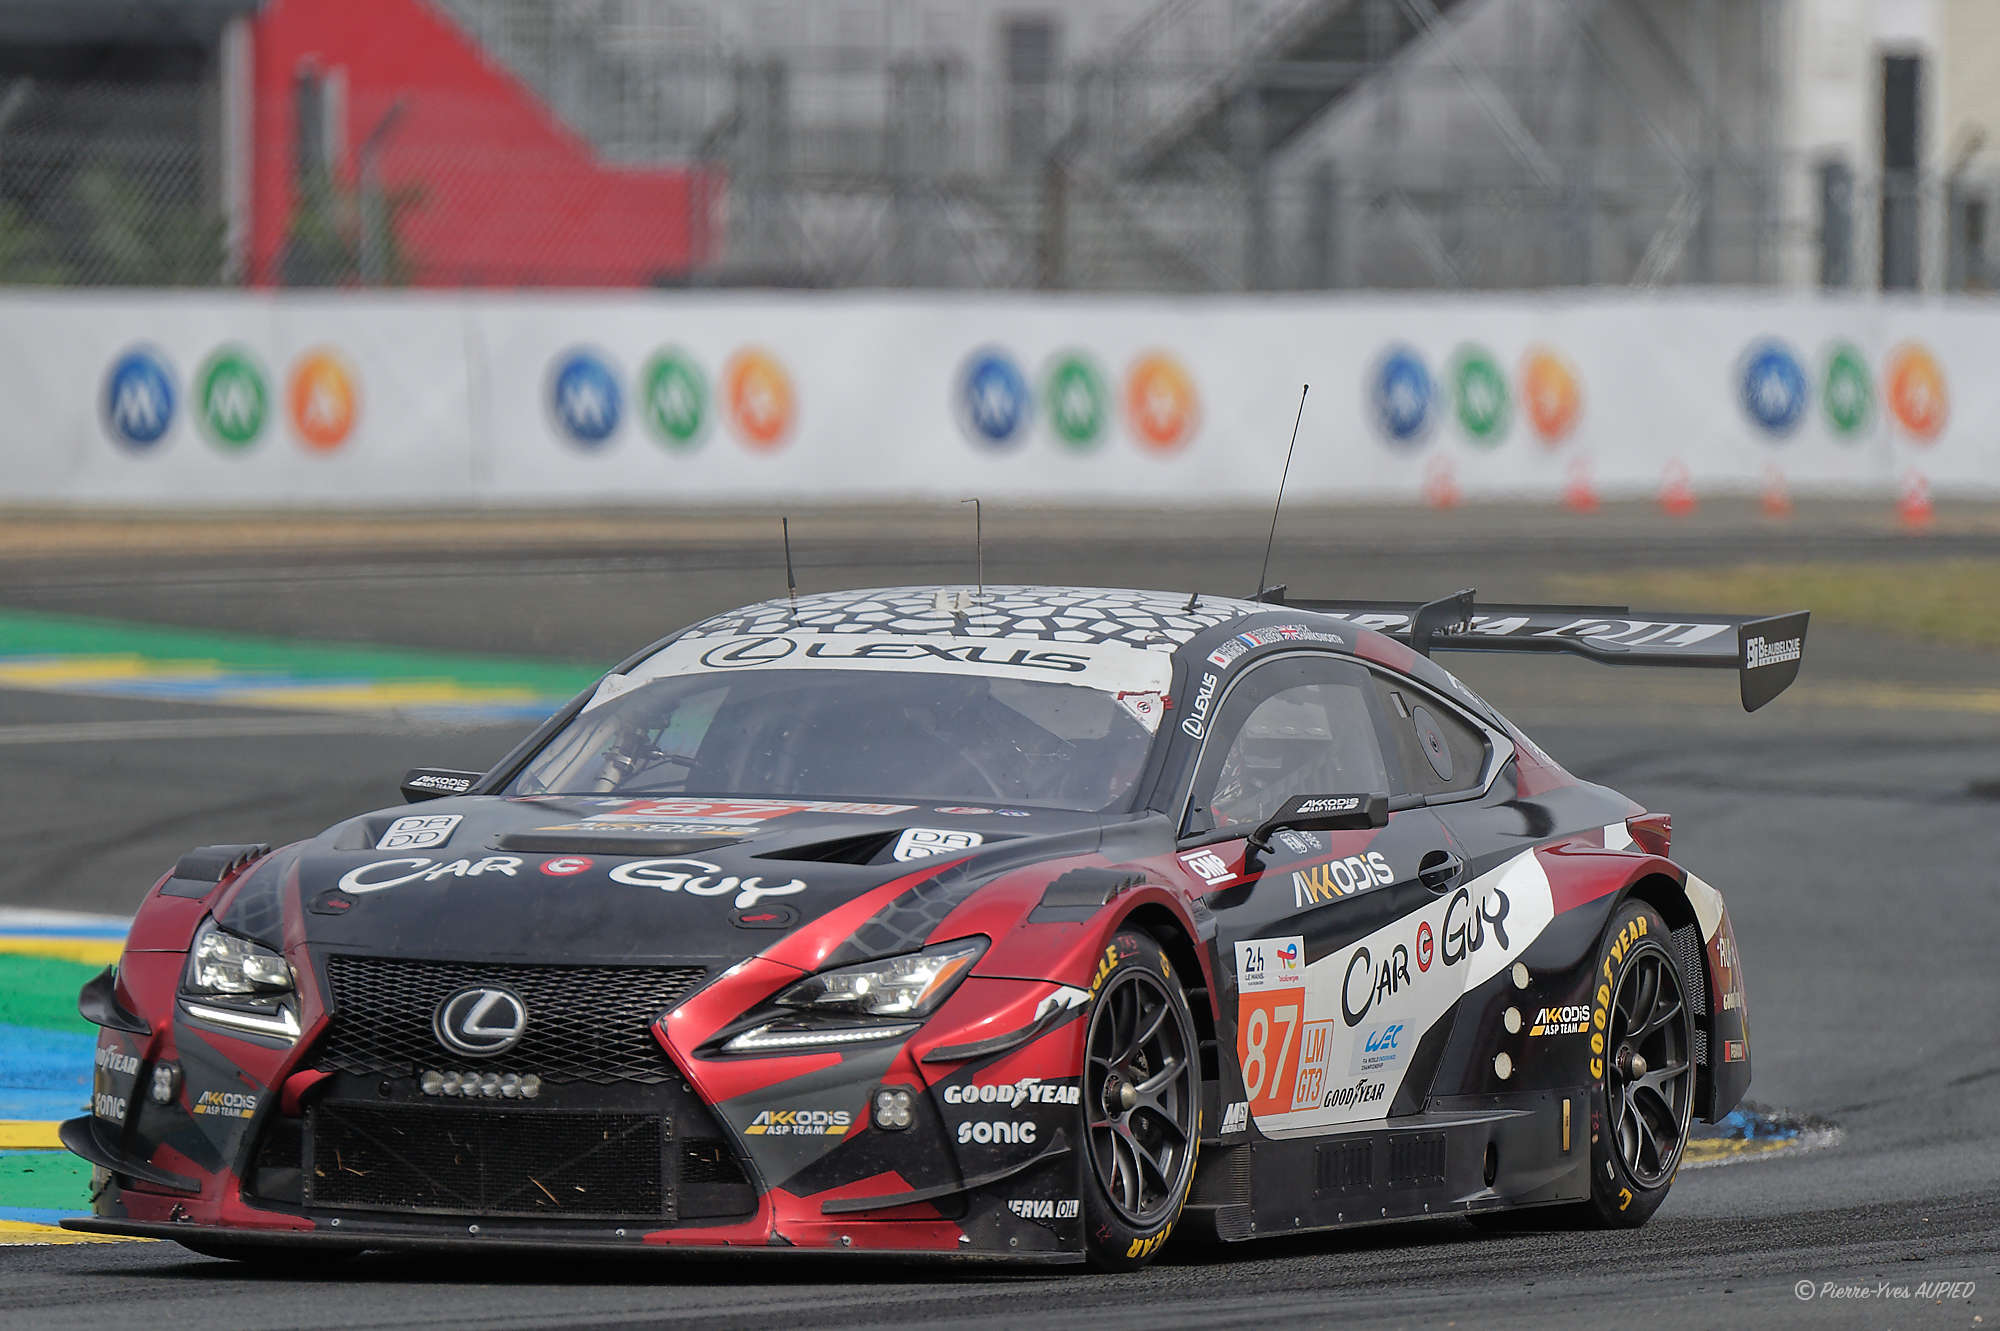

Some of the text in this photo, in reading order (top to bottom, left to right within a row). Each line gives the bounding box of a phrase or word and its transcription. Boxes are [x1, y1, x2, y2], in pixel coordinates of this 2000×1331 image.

[805, 642, 1091, 673] LEXUS
[1190, 672, 1217, 721] LEXUS
[338, 856, 523, 893] CAR
[608, 858, 807, 909] GUY
[1188, 854, 1229, 880] OMP
[1341, 943, 1411, 1027] CAR
[1441, 887, 1510, 966] GUY
[1590, 916, 1648, 1080] GOODYEAR
[1365, 1024, 1403, 1052] WEC
[1544, 1023, 1578, 1035] ASP TEAM
[1242, 1004, 1298, 1102] 87
[1304, 1028, 1326, 1064] LM
[944, 1078, 1081, 1108] GOODYEAR
[1297, 1067, 1322, 1103] GT3
[1324, 1079, 1385, 1110] GOODYEAR
[766, 1125, 825, 1135] ASP TEAM
[957, 1121, 1037, 1144] SONIC
[1055, 1199, 1080, 1218] OIL
